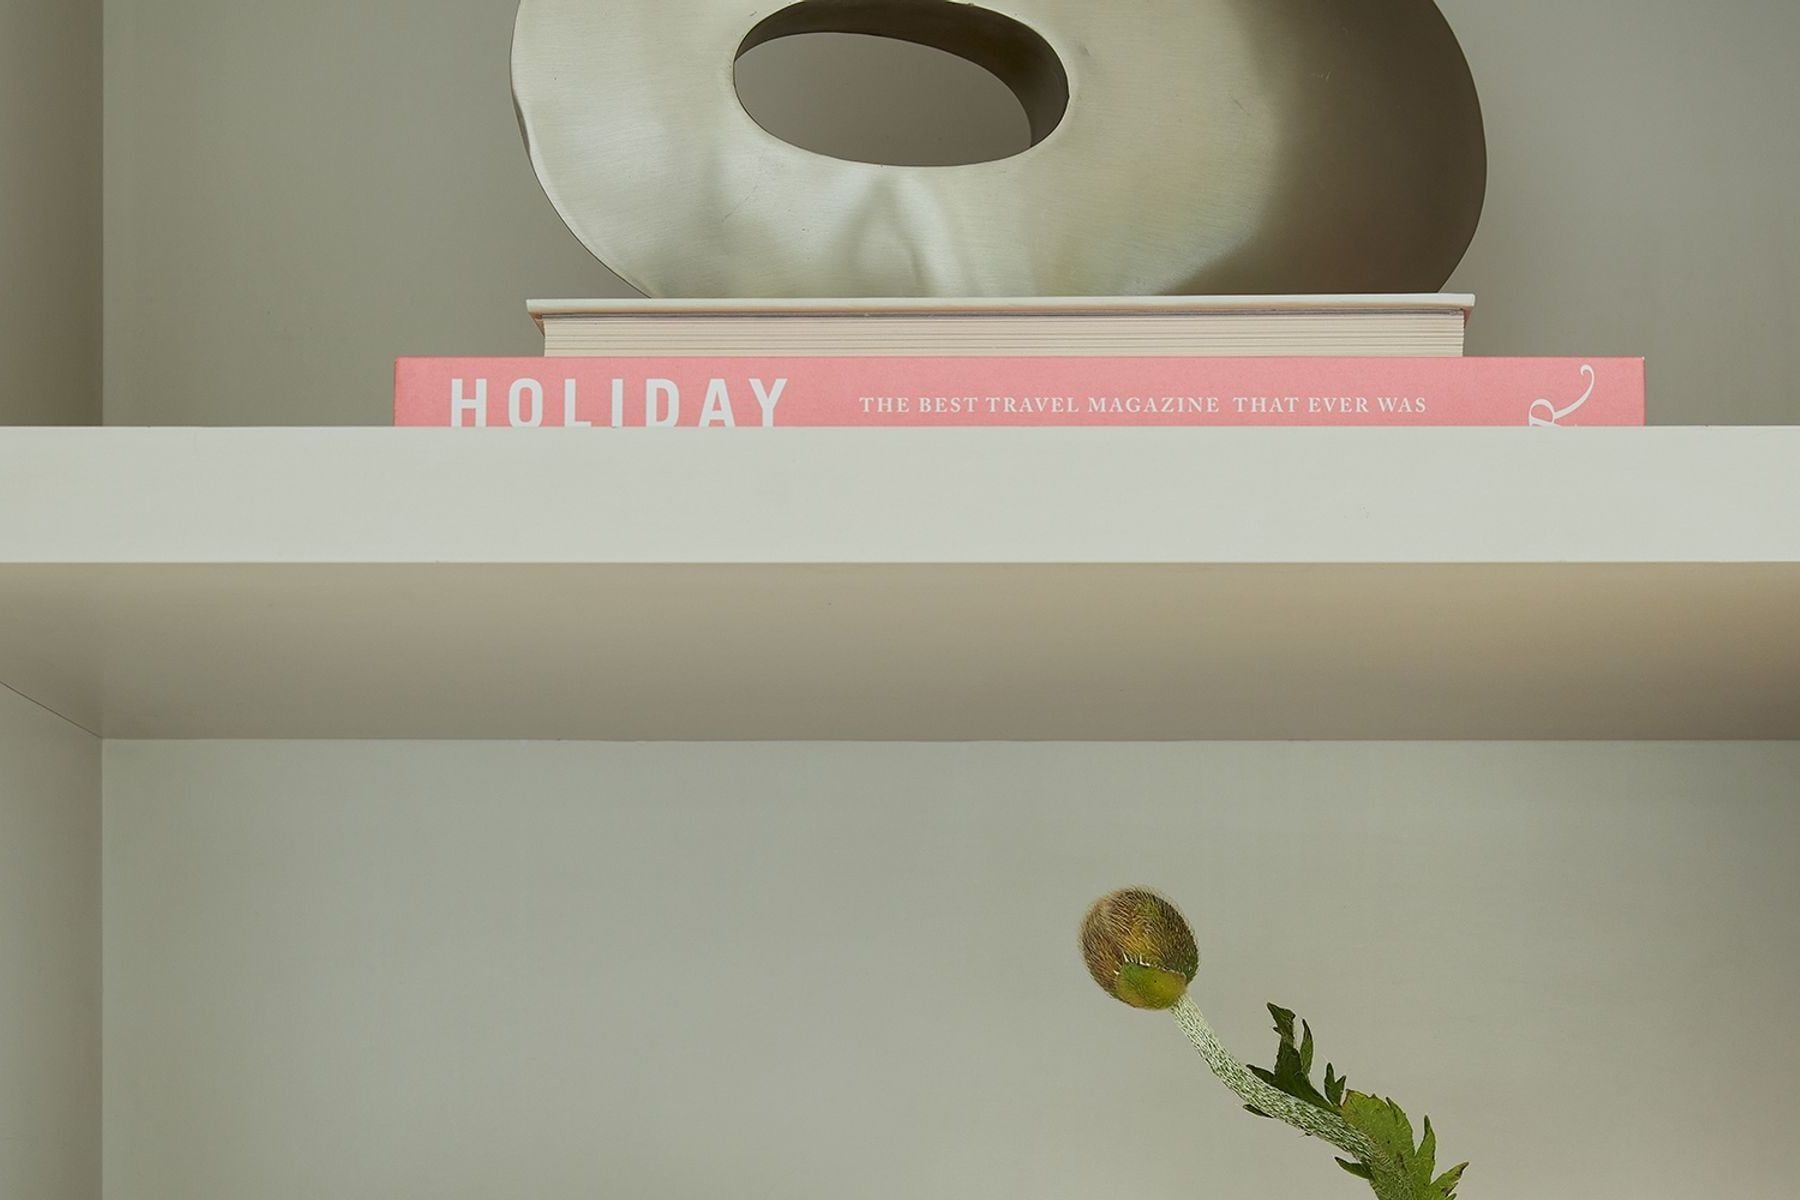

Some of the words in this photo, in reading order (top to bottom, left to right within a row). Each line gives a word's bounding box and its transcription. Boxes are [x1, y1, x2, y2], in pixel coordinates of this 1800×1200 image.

[450, 377, 788, 427] HOLIDAY
[859, 397, 909, 413] THE
[919, 397, 978, 413] BEST
[985, 397, 1079, 413] TRAVEL
[1088, 397, 1219, 413] MAGAZINE
[1232, 396, 1300, 413] THAT
[1308, 397, 1369, 413] EVER
[1377, 397, 1427, 413] WAS
